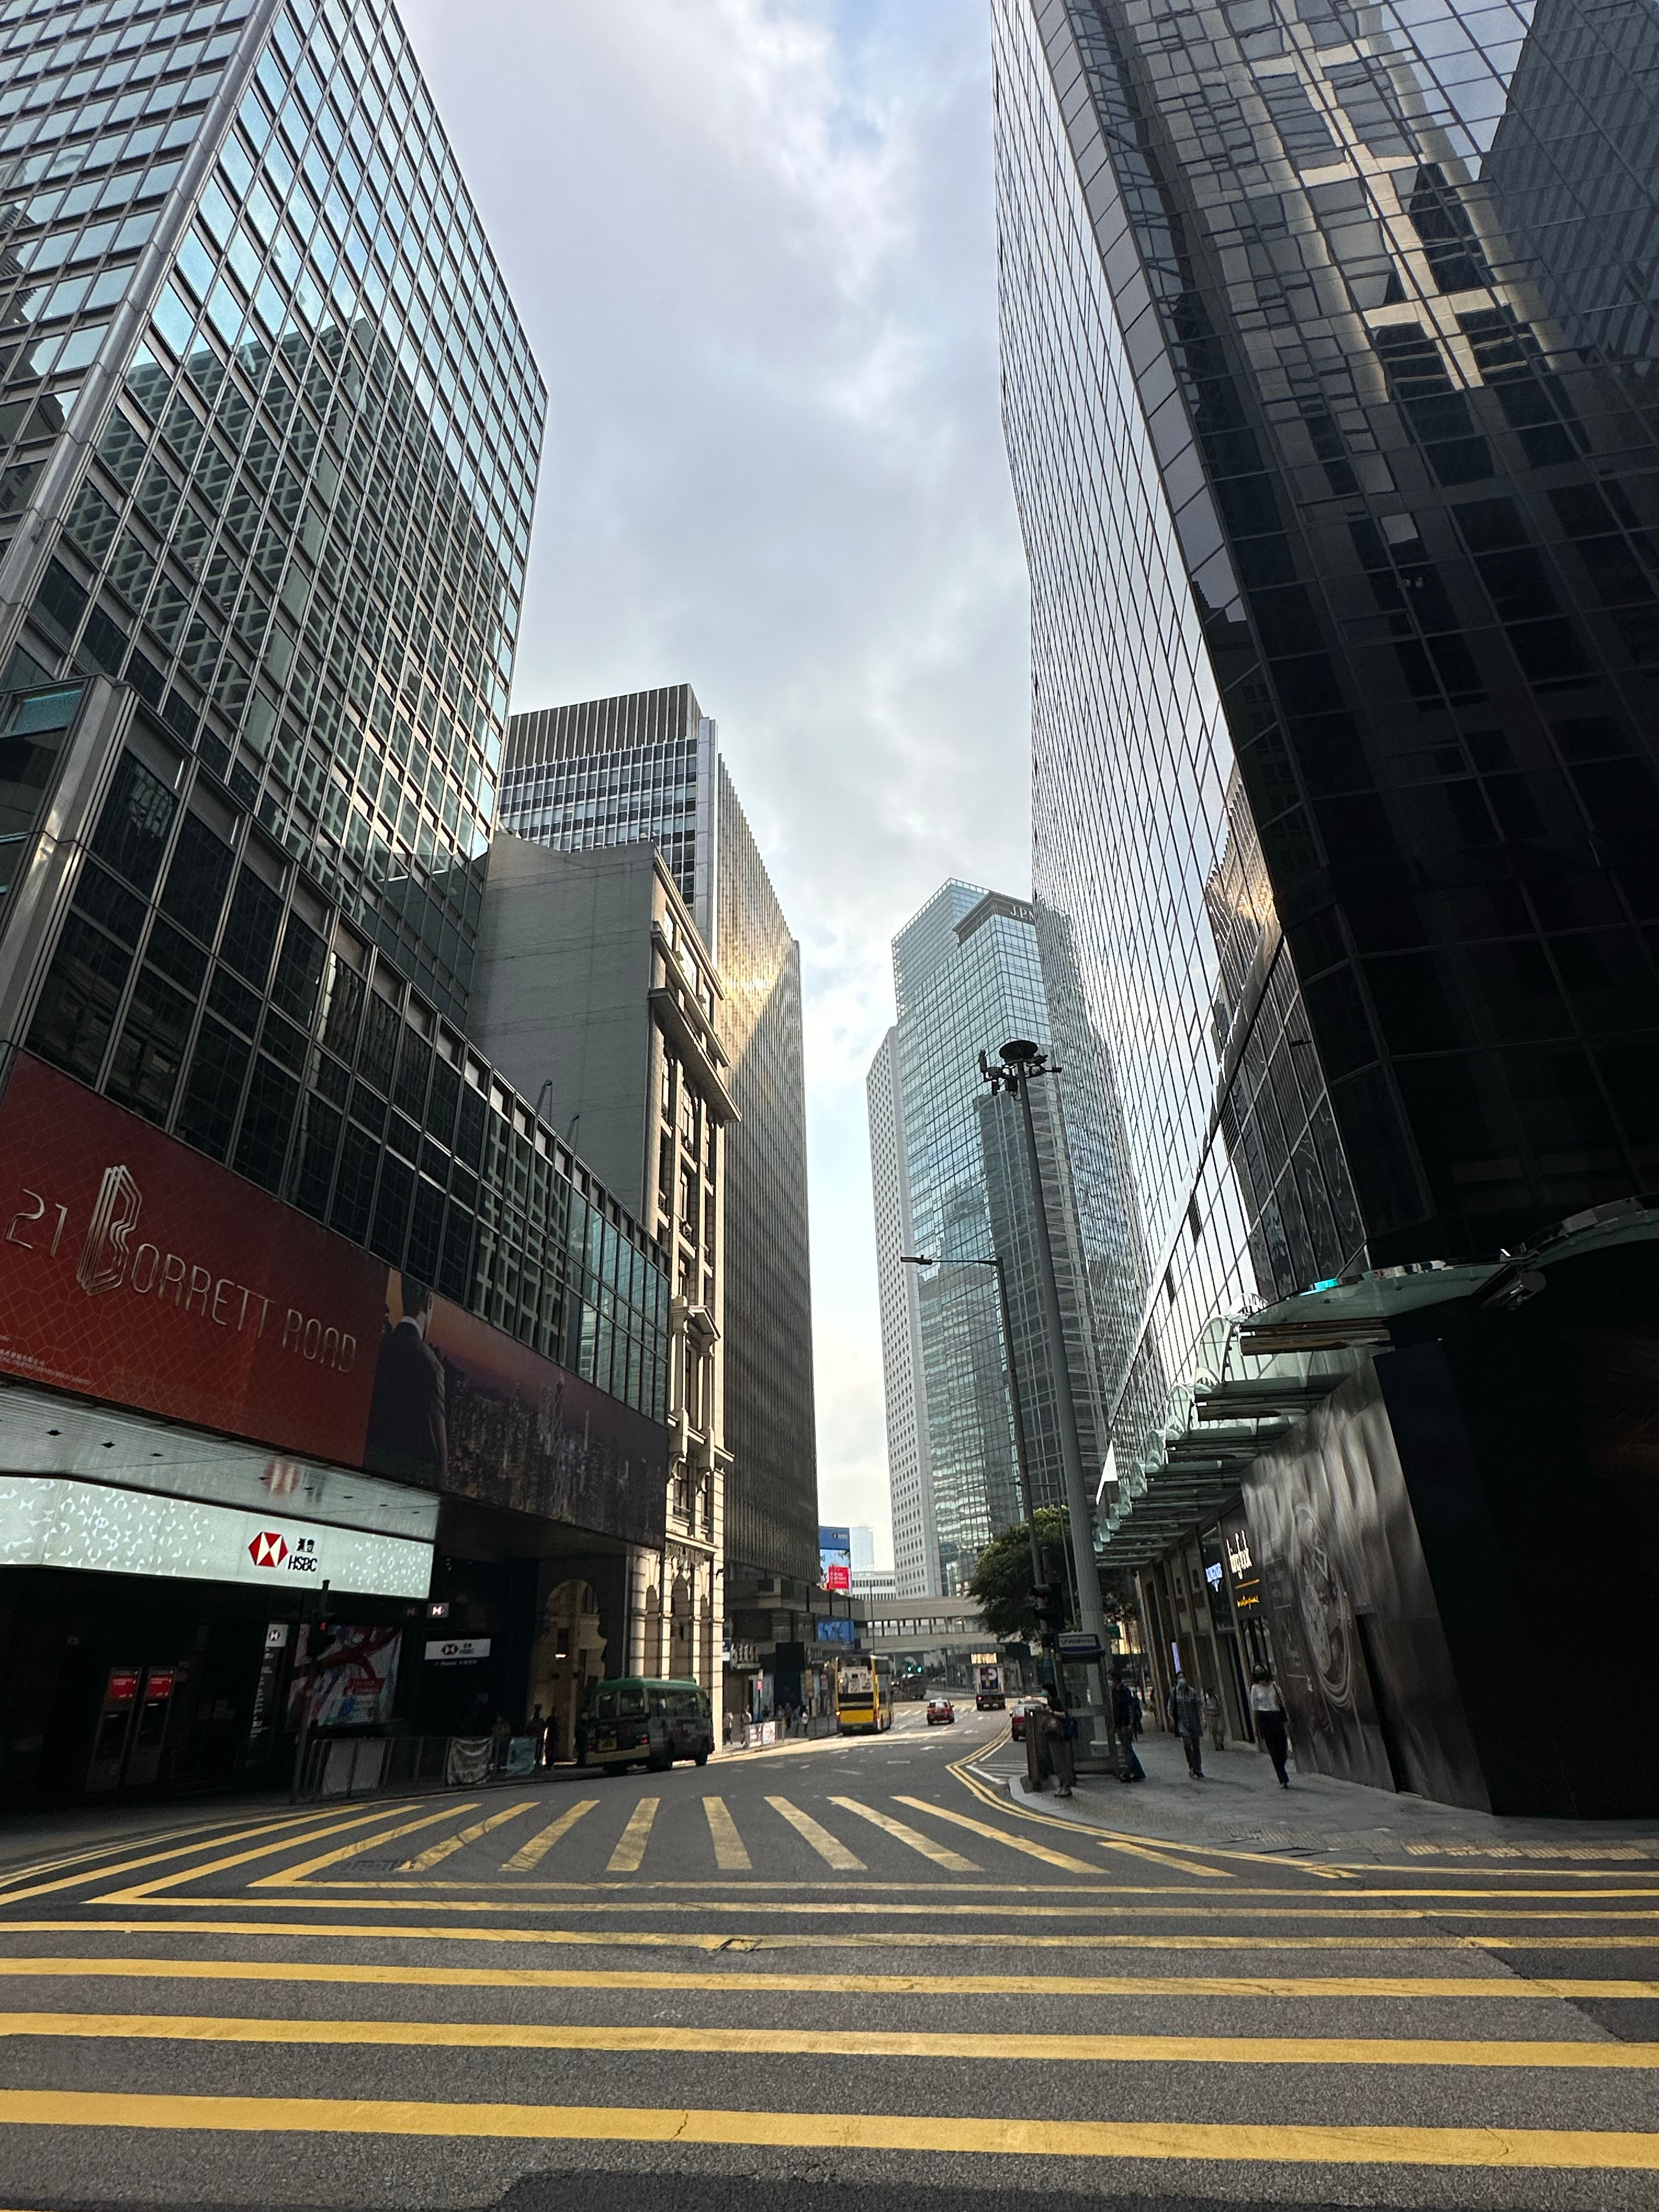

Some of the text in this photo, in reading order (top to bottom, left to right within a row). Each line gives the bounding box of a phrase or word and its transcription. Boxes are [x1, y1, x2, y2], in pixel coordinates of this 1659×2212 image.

[5, 1188, 68, 1258] 21
[282, 1308, 357, 1373] ROAD
[288, 1555, 318, 1572] HSBC
